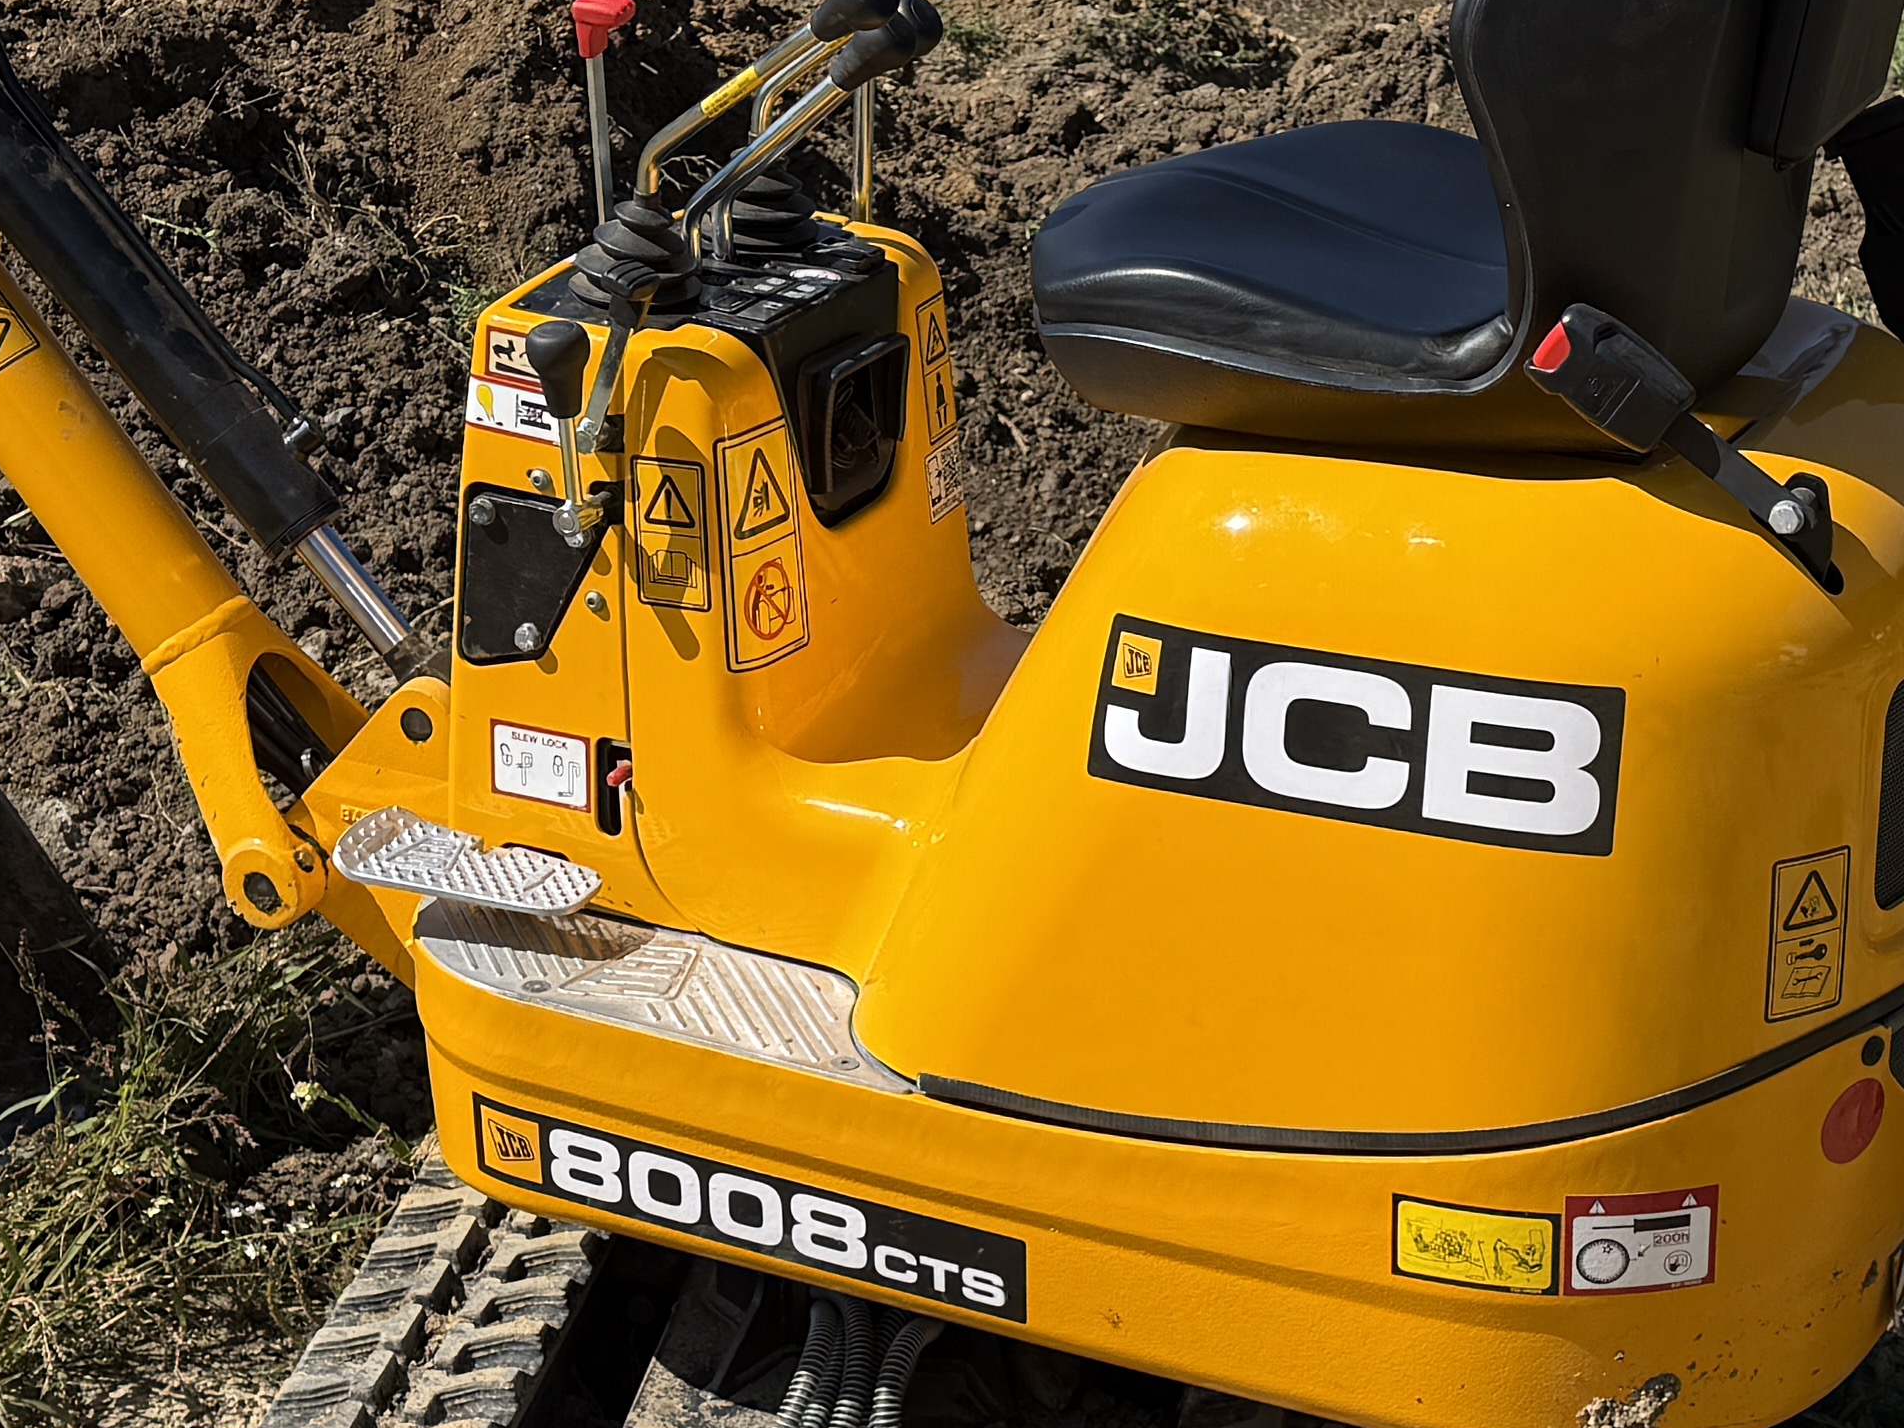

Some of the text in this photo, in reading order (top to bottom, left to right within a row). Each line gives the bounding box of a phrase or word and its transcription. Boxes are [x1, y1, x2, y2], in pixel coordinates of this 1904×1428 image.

[511, 731, 568, 750] SLEW LOCK
[1104, 646, 1601, 836] JCB
[496, 1124, 531, 1158] JCB
